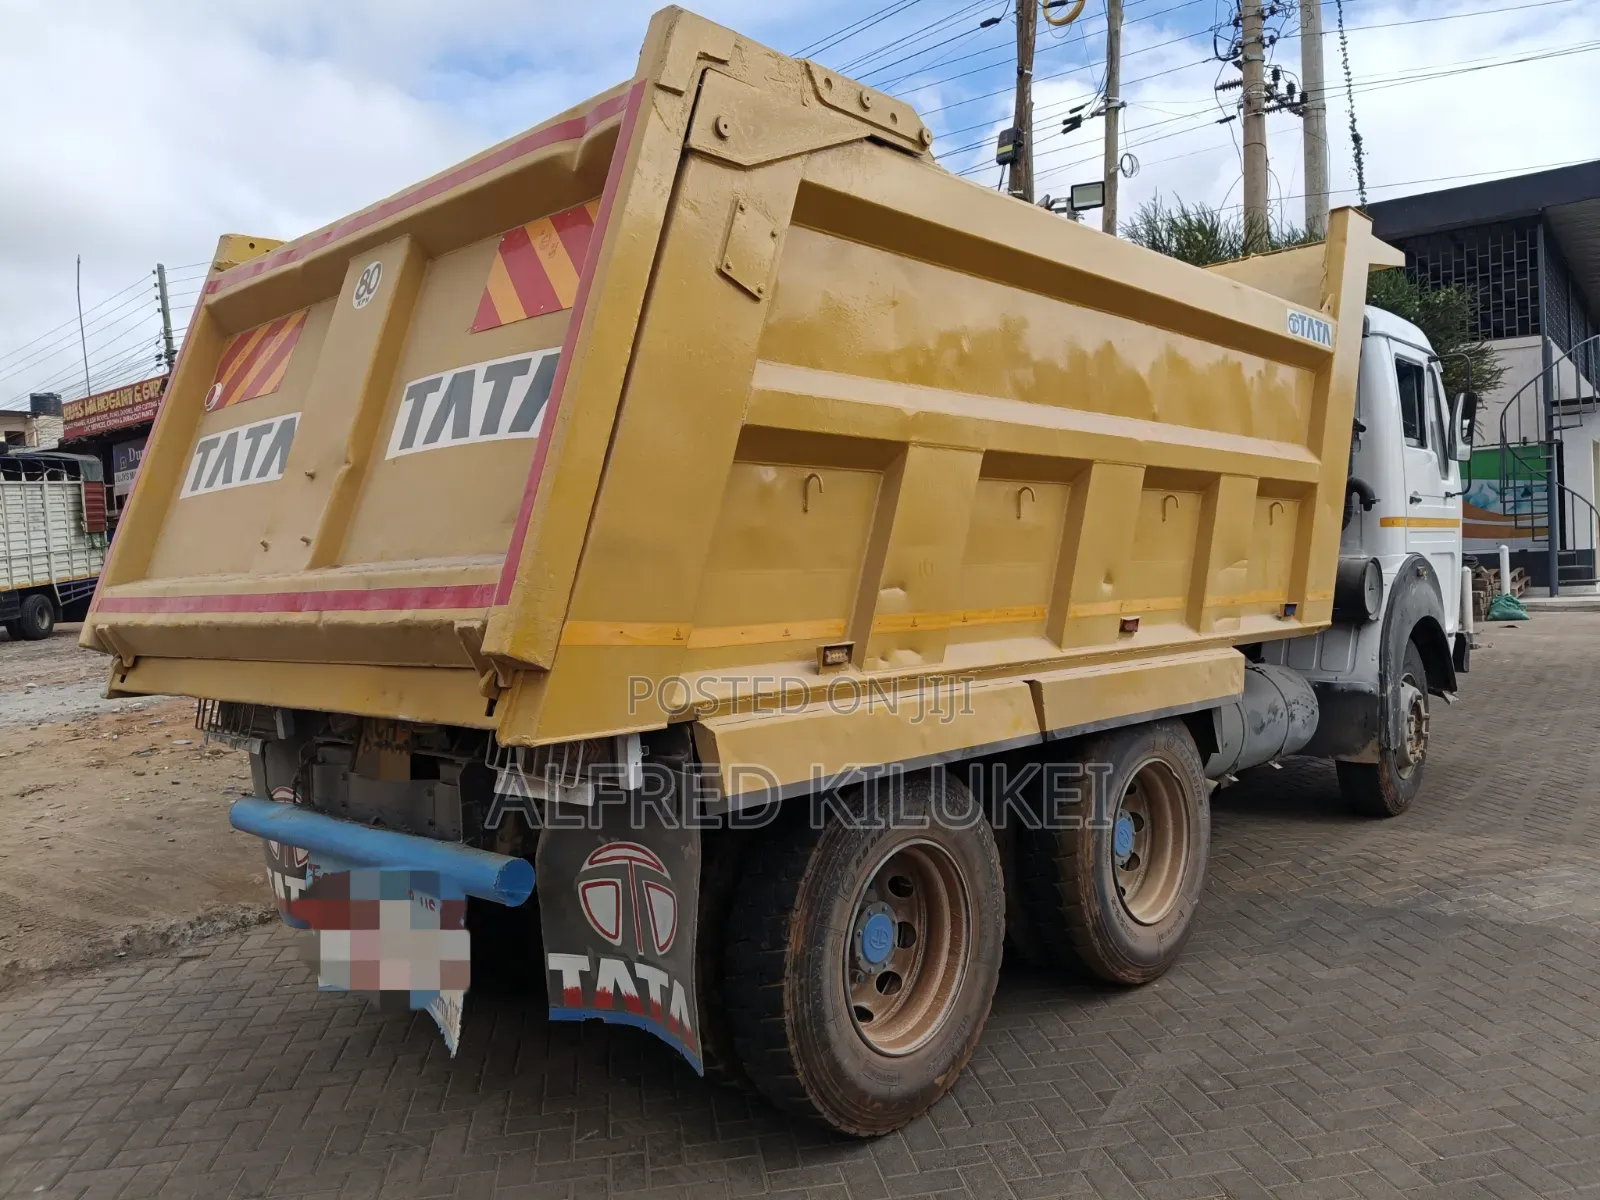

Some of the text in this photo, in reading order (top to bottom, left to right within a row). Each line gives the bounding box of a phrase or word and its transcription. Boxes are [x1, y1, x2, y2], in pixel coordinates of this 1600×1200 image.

[355, 263, 382, 300] 80
[1298, 313, 1331, 347] TATA
[85, 387, 133, 416] MAHOGANY
[134, 384, 142, 403] &
[190, 417, 297, 492] TATA
[547, 953, 697, 1053] TATA
